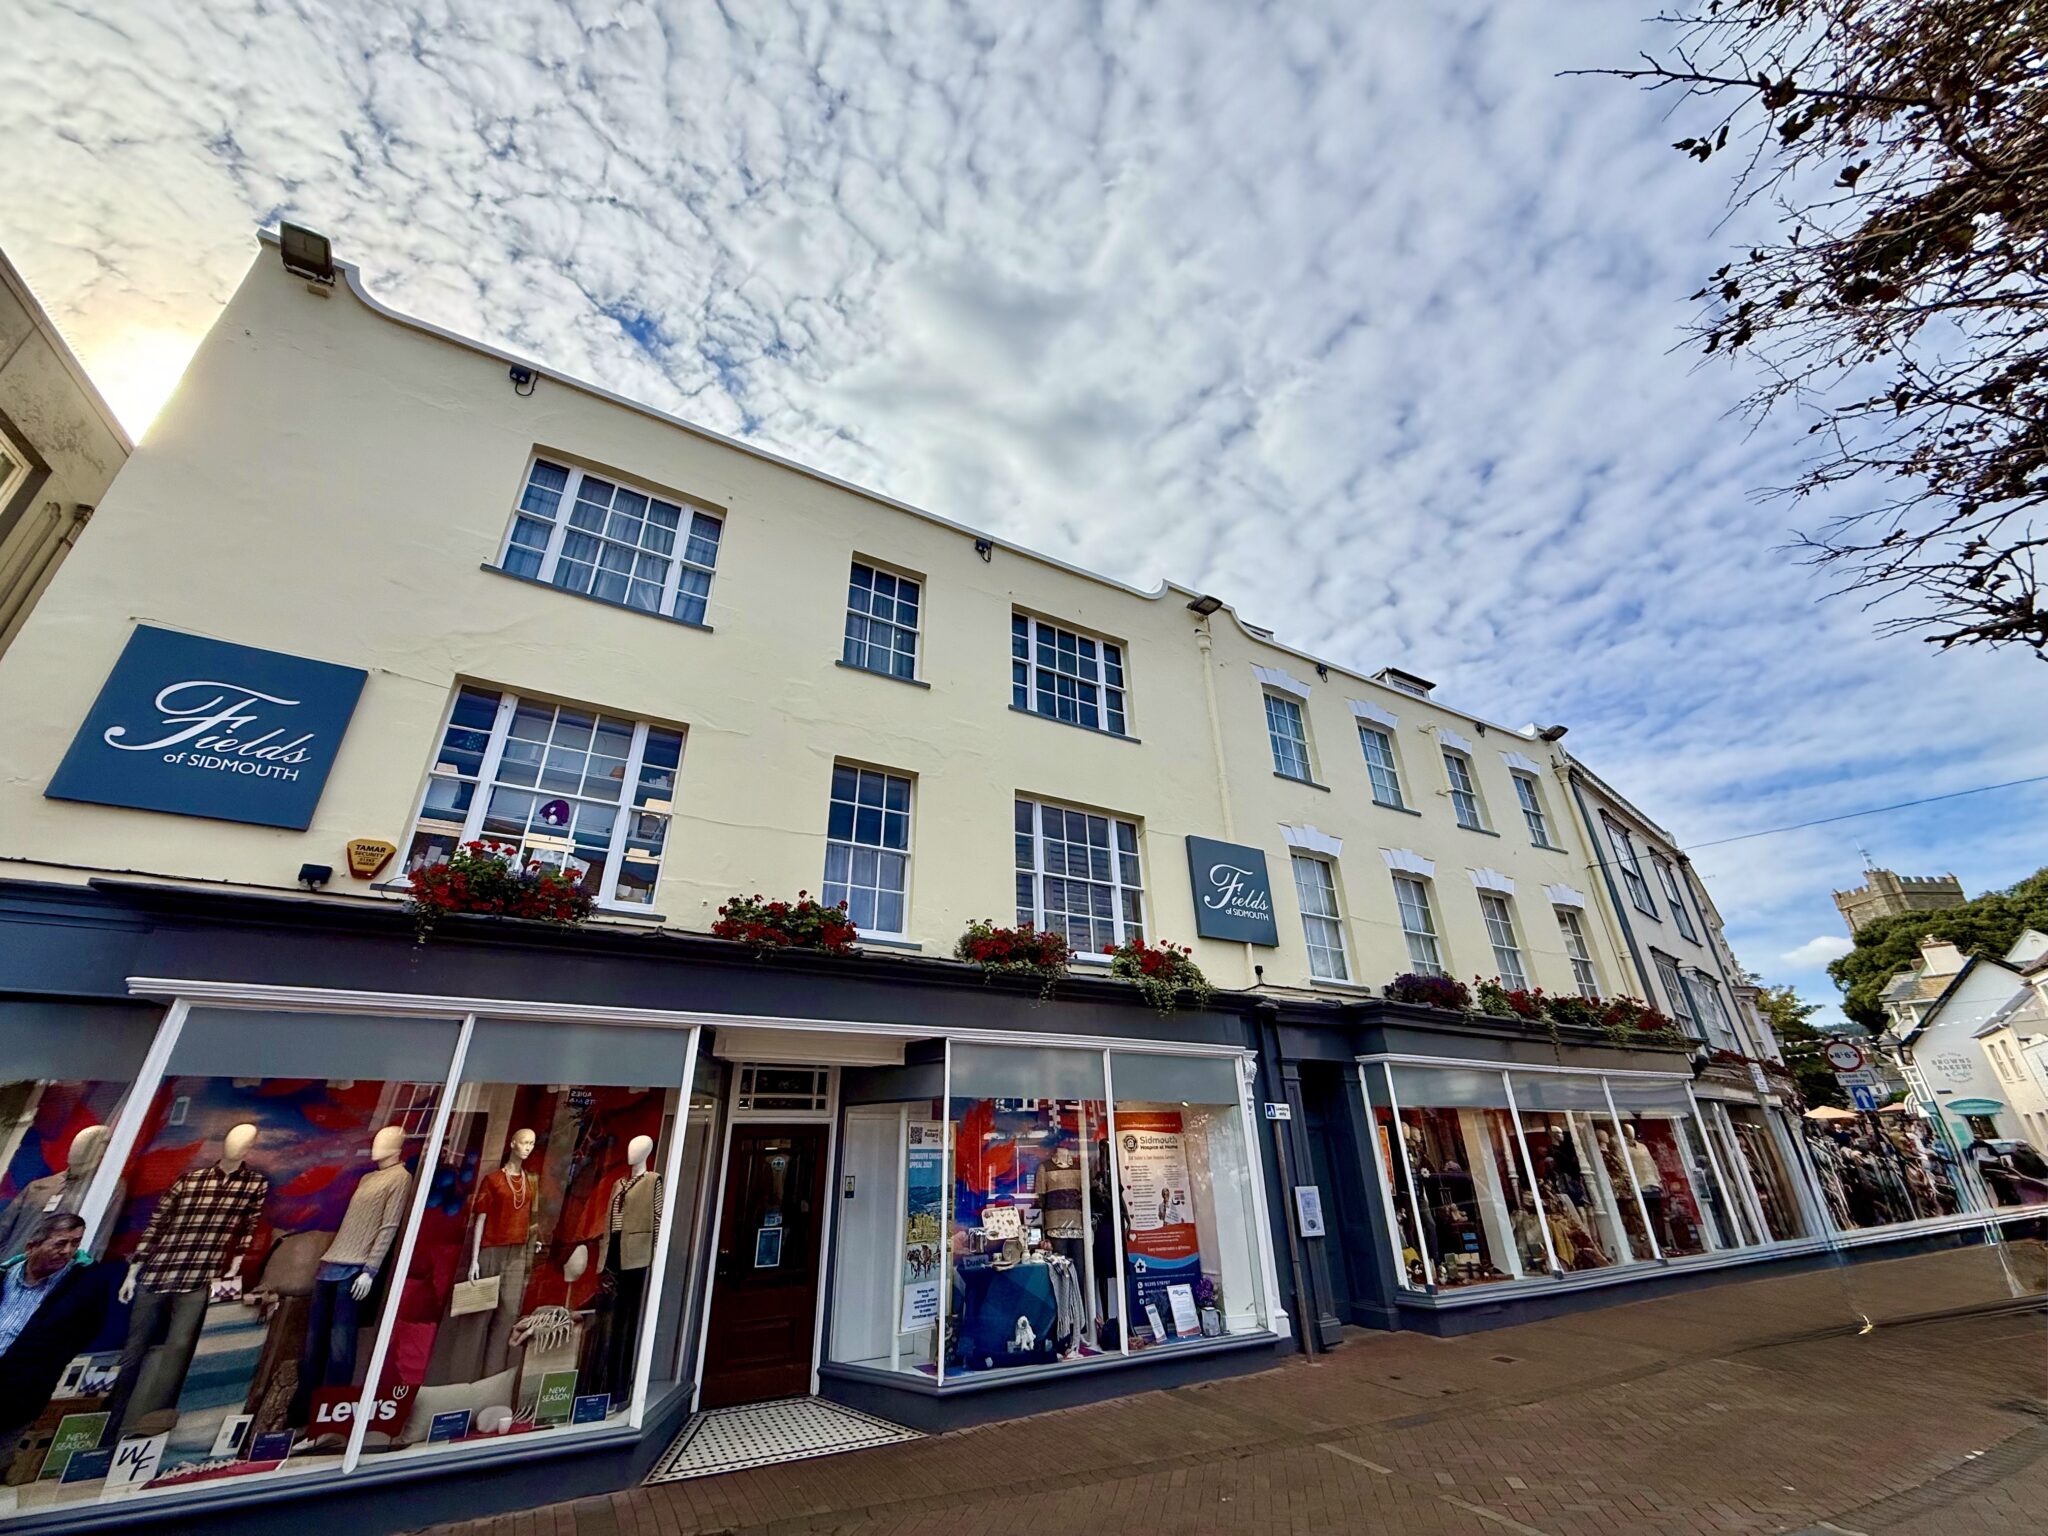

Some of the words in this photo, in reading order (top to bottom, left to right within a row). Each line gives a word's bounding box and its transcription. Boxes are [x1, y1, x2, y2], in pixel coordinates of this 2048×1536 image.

[103, 680, 315, 764] Fields
[162, 751, 188, 765] of
[187, 753, 300, 782] SIDMOUTH
[355, 844, 387, 852] TAMAR
[1203, 863, 1269, 911] Fields
[1225, 908, 1233, 916] of
[1232, 907, 1269, 921] SIDMOUTH
[1930, 1057, 1972, 1066] BROWNS
[1936, 1063, 1973, 1071] BAKERY
[1139, 1135, 1178, 1144] Sidmouth
[549, 1385, 568, 1395] NEW
[541, 1392, 571, 1403] SEASON
[66, 1431, 92, 1441] NEW
[54, 1440, 96, 1452] SEASON
